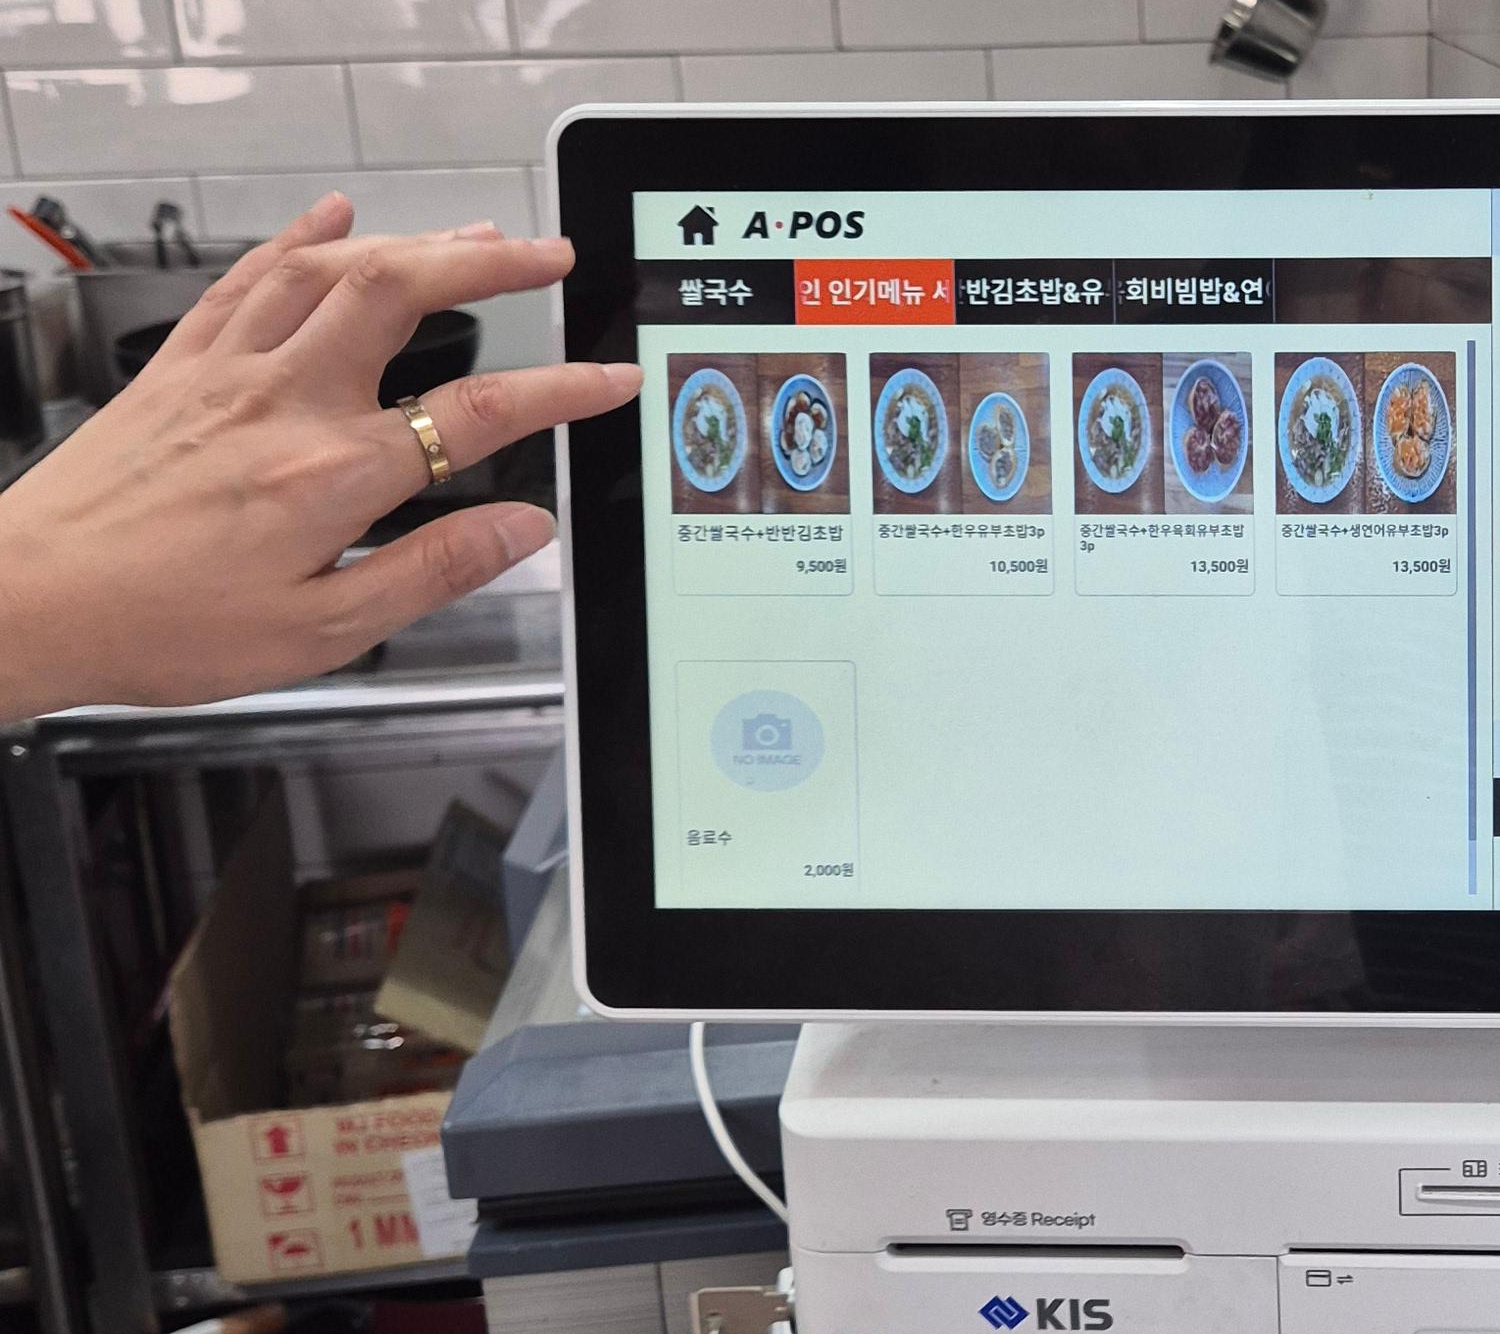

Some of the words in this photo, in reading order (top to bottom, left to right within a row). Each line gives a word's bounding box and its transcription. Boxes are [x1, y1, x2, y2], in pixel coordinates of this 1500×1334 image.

[678, 278, 753, 307] 쌀국수
[828, 278, 925, 306] 인기메뉴
[962, 277, 1107, 307] 반김초밥&유
[1119, 276, 1266, 307] 회비빔밥&연
[1080, 540, 1095, 553] 3p
[796, 558, 848, 574] 9,500원
[990, 558, 1049, 574] 10,500원
[1190, 558, 1250, 575] 13,500원
[1392, 558, 1451, 575] 13,500원
[686, 829, 732, 846] 음료수
[804, 863, 854, 877] 2,000원
[981, 1211, 1027, 1226] 영수증
[1031, 1212, 1096, 1229] Receipt
[1036, 1298, 1113, 1331] KIS
